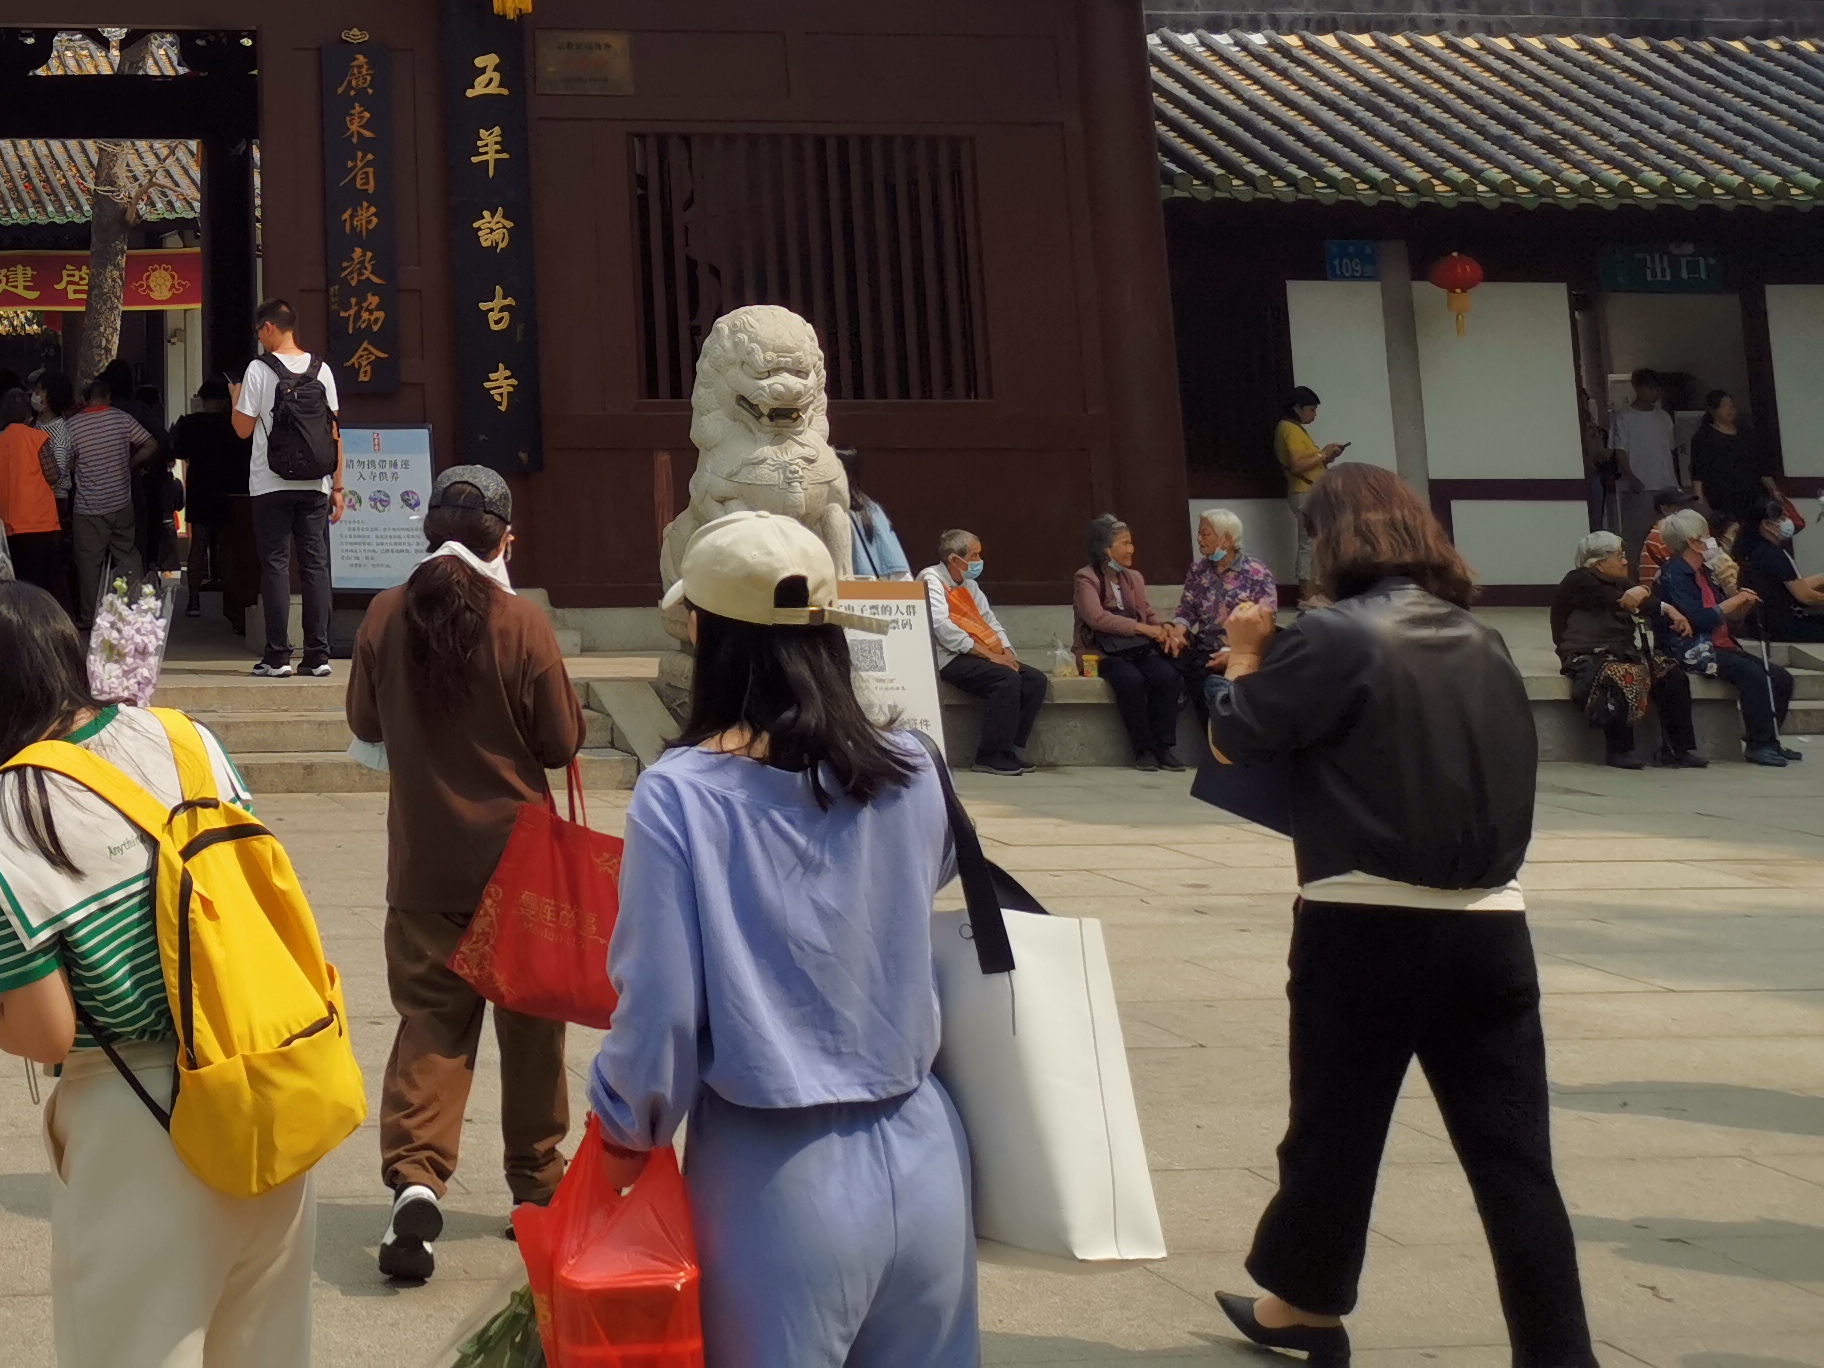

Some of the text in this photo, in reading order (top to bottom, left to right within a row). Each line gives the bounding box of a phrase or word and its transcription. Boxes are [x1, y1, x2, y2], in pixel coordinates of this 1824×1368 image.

[337, 54, 389, 383] 廣東省佛教協會
[465, 53, 519, 413] 五羊論古寺
